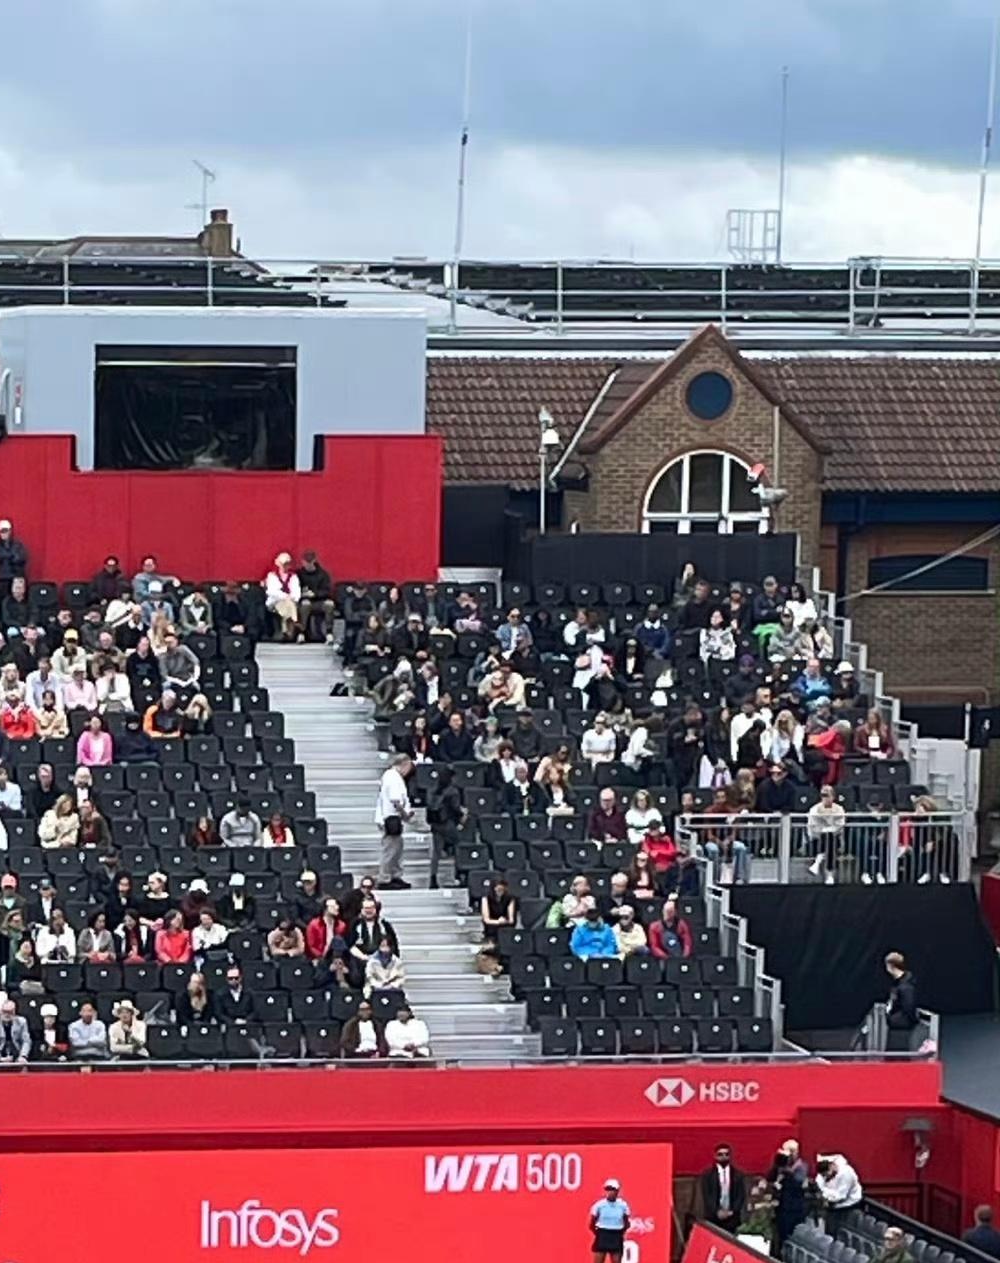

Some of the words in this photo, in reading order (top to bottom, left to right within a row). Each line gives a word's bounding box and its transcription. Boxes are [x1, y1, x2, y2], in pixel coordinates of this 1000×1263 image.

[699, 1081, 761, 1103] HSBC
[424, 1153, 518, 1193] WTA
[525, 1152, 582, 1191] 500
[201, 1199, 340, 1256] Infosys
